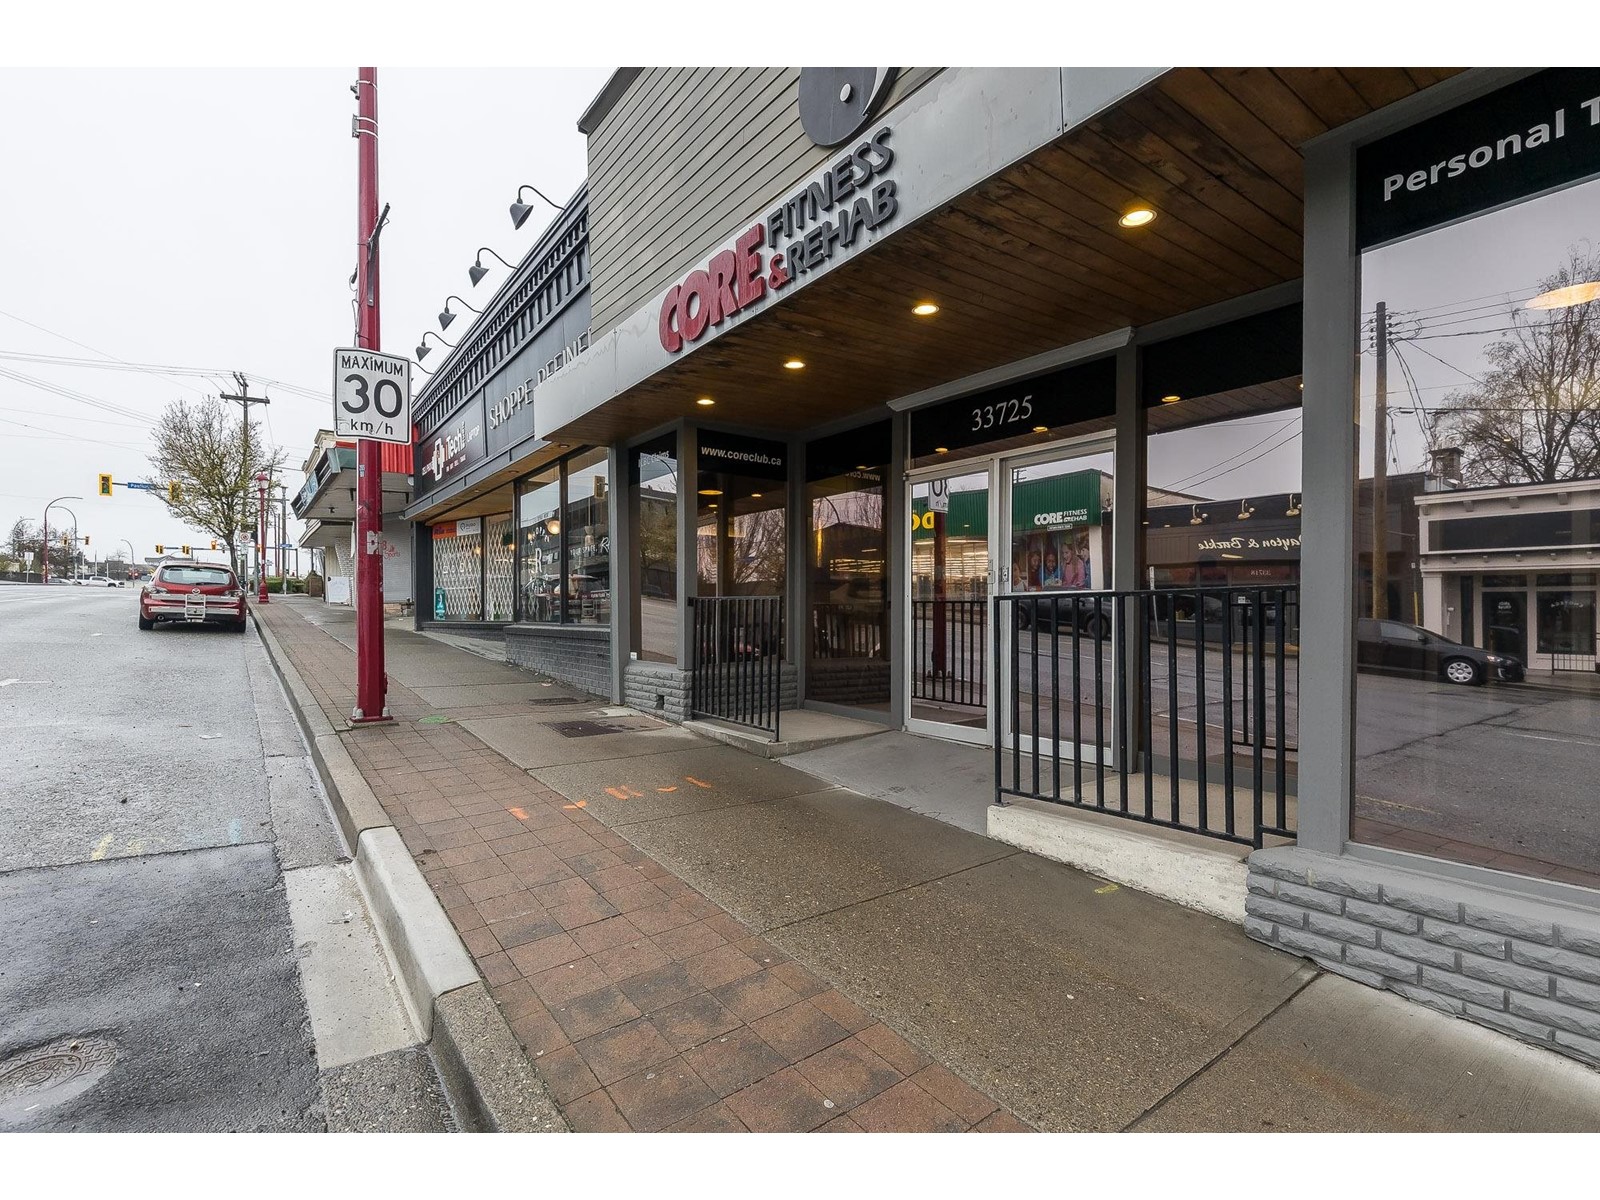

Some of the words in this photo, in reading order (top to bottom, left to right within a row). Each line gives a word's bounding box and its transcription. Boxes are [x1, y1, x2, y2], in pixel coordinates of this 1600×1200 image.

[1384, 108, 1565, 201] Personal
[767, 127, 895, 249] FITNESS
[785, 180, 899, 282] REHAB
[659, 223, 767, 353] CORE
[341, 355, 404, 377] MAXIMUM
[341, 373, 403, 419] 30
[489, 377, 534, 430] SHOPPE
[971, 395, 1033, 432] 33725
[350, 418, 394, 435] km/h
[701, 445, 782, 466] www.coreclub.ca
[1033, 511, 1063, 526] CORE
